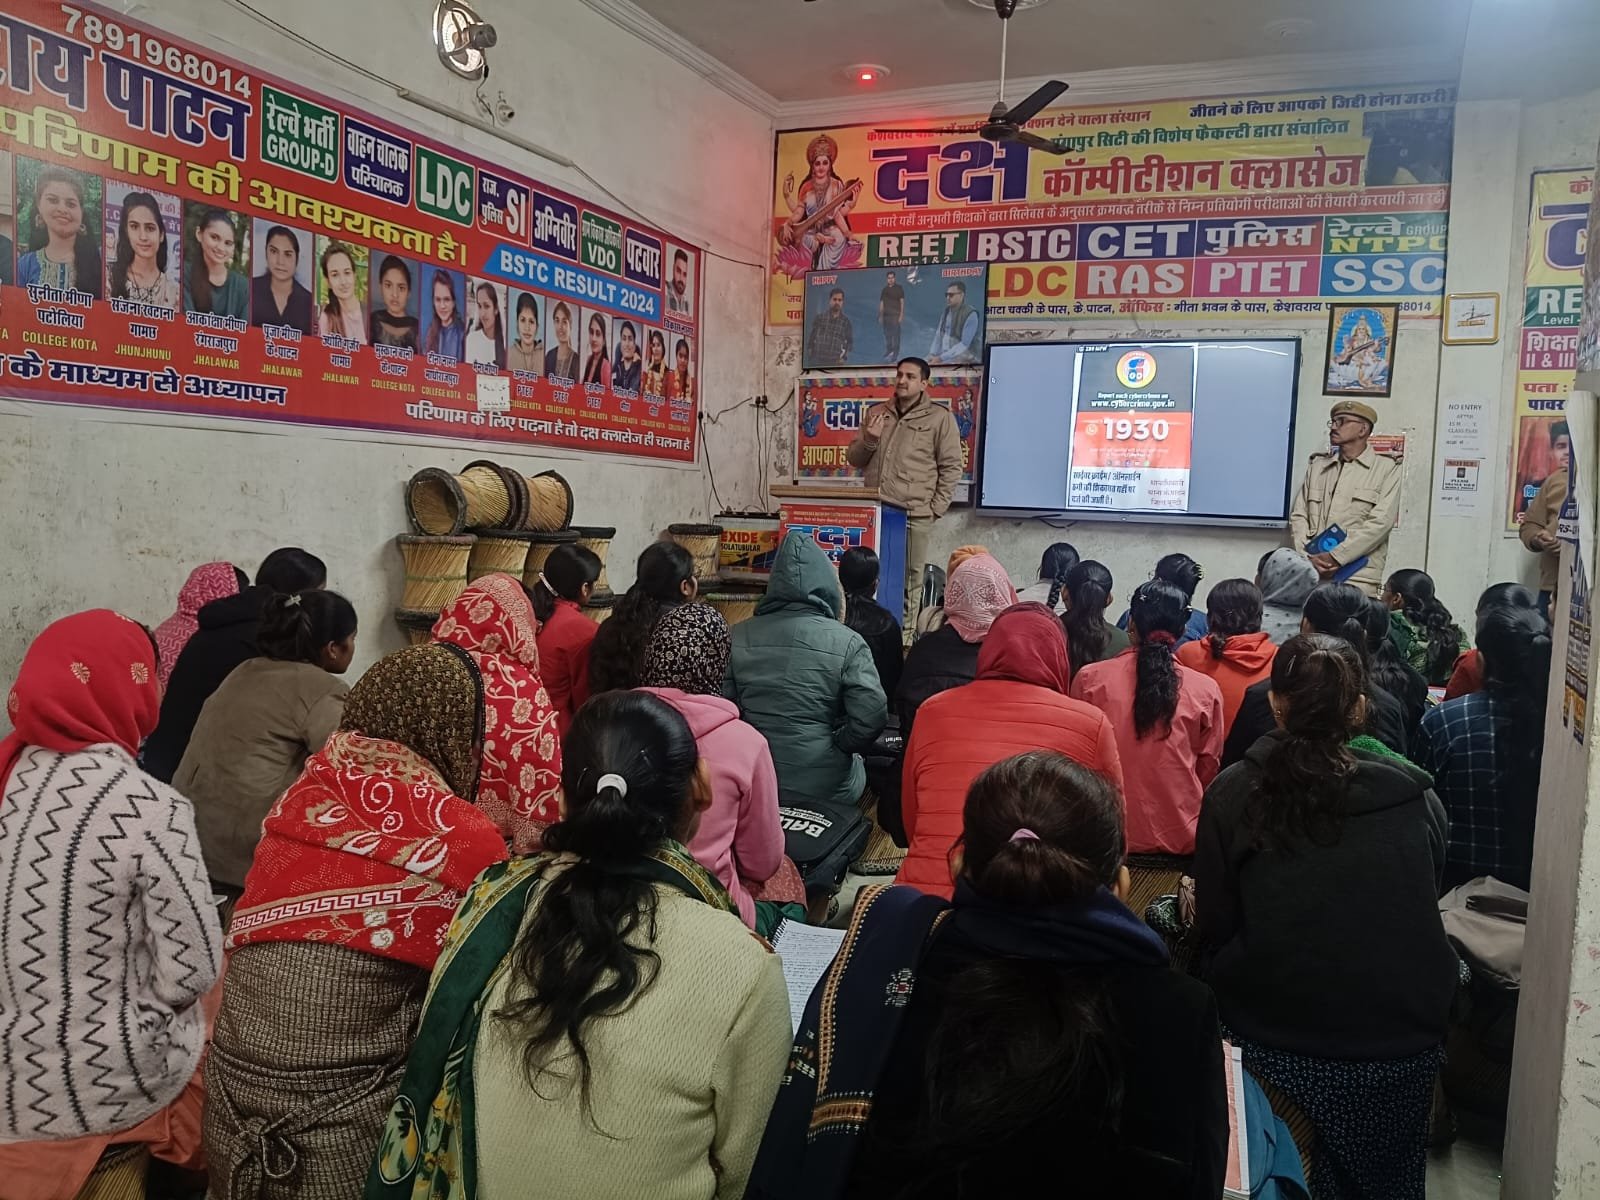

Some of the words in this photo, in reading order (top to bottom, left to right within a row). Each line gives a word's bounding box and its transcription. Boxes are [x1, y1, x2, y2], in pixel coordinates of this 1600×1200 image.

[61, 6, 251, 98] 7891968014
[100, 52, 251, 161] पाटन
[1057, 113, 1074, 126] देने
[1078, 113, 1106, 125] वाला
[1109, 109, 1152, 123] संस्थान
[1190, 101, 1228, 118] जीतने
[1230, 100, 1243, 115] के
[1246, 100, 1274, 115] लिए
[1277, 96, 1326, 112] आपको
[303, 115, 336, 150] भर्ती
[1097, 130, 1128, 147] सिटी
[1131, 129, 1149, 144] की
[1153, 126, 1192, 144] विशेष
[1196, 122, 1250, 140] फैकल्टी
[1253, 120, 1284, 138] द्वारा
[1286, 117, 1349, 136] संचालित
[266, 134, 334, 177] GROUP-D
[347, 128, 375, 162] वाहन
[377, 137, 409, 173] चालक
[0, 106, 181, 185] परिणाम
[187, 160, 243, 202] की
[249, 180, 433, 256] आवश्यकता
[351, 164, 404, 197] परिचालक
[870, 139, 1031, 208] दक्ष
[1043, 154, 1224, 197] कॉम्पीटीशन
[1230, 145, 1365, 191] क्लासेज
[420, 157, 470, 217] LDC
[481, 202, 503, 225] पुलिस
[506, 189, 526, 237] SI
[876, 214, 899, 227] हमारे
[917, 211, 951, 227] अनुभवी
[953, 208, 989, 224] शिक्षकों
[989, 209, 1007, 222] द्वारा
[1009, 207, 1044, 221] सिलेबस
[1047, 206, 1057, 218] के
[1059, 204, 1094, 220] अनुसार
[1097, 203, 1134, 216] क्रमबद्ध
[1136, 200, 1165, 214] तरीके
[1167, 200, 1176, 213] से
[1179, 199, 1204, 213] निम्न
[1207, 197, 1251, 212] प्रतियोगी
[1254, 194, 1306, 210] परीक्षाओं
[1306, 194, 1322, 208] की
[1324, 192, 1358, 208] तैयारी
[1407, 190, 1424, 204] जा
[534, 206, 576, 250] अग्निवीर
[1087, 223, 1189, 258] CET
[1204, 221, 1316, 256] पुलिस
[1327, 216, 1405, 238] रेल्वे
[588, 242, 616, 270] VDO
[626, 238, 660, 279] पटवार
[878, 233, 960, 258] REET
[978, 228, 1071, 261] BSTC
[1330, 236, 1446, 253] NTPC
[500, 250, 548, 283] BSTC
[554, 267, 616, 303] RESULT
[620, 288, 654, 315] 2024
[988, 265, 1068, 298] DC
[1087, 263, 1185, 295] RAS
[1209, 260, 1307, 293] PTET
[1331, 257, 1444, 293] SSC
[27, 284, 63, 304] सुनीता
[64, 288, 93, 307] मीणा
[111, 297, 141, 316] संजना
[1008, 303, 1033, 314] चक्की
[1036, 302, 1046, 314] के
[1119, 300, 1164, 313] ऑफिस
[1174, 301, 1198, 312] गीता
[1202, 303, 1227, 311] भवन
[1231, 300, 1242, 311] के
[1273, 299, 1321, 312] केशवराय
[37, 307, 84, 328] पटोलिया
[186, 311, 223, 330] आकांक्षा
[224, 315, 247, 333] मीणा
[1543, 315, 1573, 325] Level
[23, 330, 67, 347] COLLEGE
[71, 337, 97, 351] KOTA
[263, 323, 280, 342] पूजा
[281, 324, 302, 342] मीणा
[115, 344, 171, 360] JHUNJHUNU
[193, 354, 239, 369] JHALAWAR
[1541, 353, 1552, 368] &
[9, 349, 44, 378] के
[49, 360, 149, 391] माध्यम
[152, 366, 181, 394] से
[185, 374, 287, 406] अध्यापन
[261, 364, 302, 378] JHALAWAR
[321, 371, 359, 385] JHALAWAR
[371, 378, 398, 391] COLLEGE
[398, 382, 415, 393] KOTA
[421, 386, 446, 399] COLLEGE
[1523, 382, 1559, 393] पता
[405, 400, 467, 424] परिणाम
[489, 411, 516, 431] लिए
[518, 418, 552, 436] पढ़ना
[554, 419, 565, 435] है
[565, 420, 578, 437] तो
[580, 426, 599, 440] दक्ष
[601, 428, 642, 445] क्लासेज
[644, 431, 654, 446] ही
[655, 436, 683, 449] चलना
[683, 437, 692, 451] है
[824, 398, 861, 431] दक्ष
[1103, 418, 1169, 440] 1930
[802, 445, 837, 466] आपका
[720, 532, 758, 543] EXIDE
